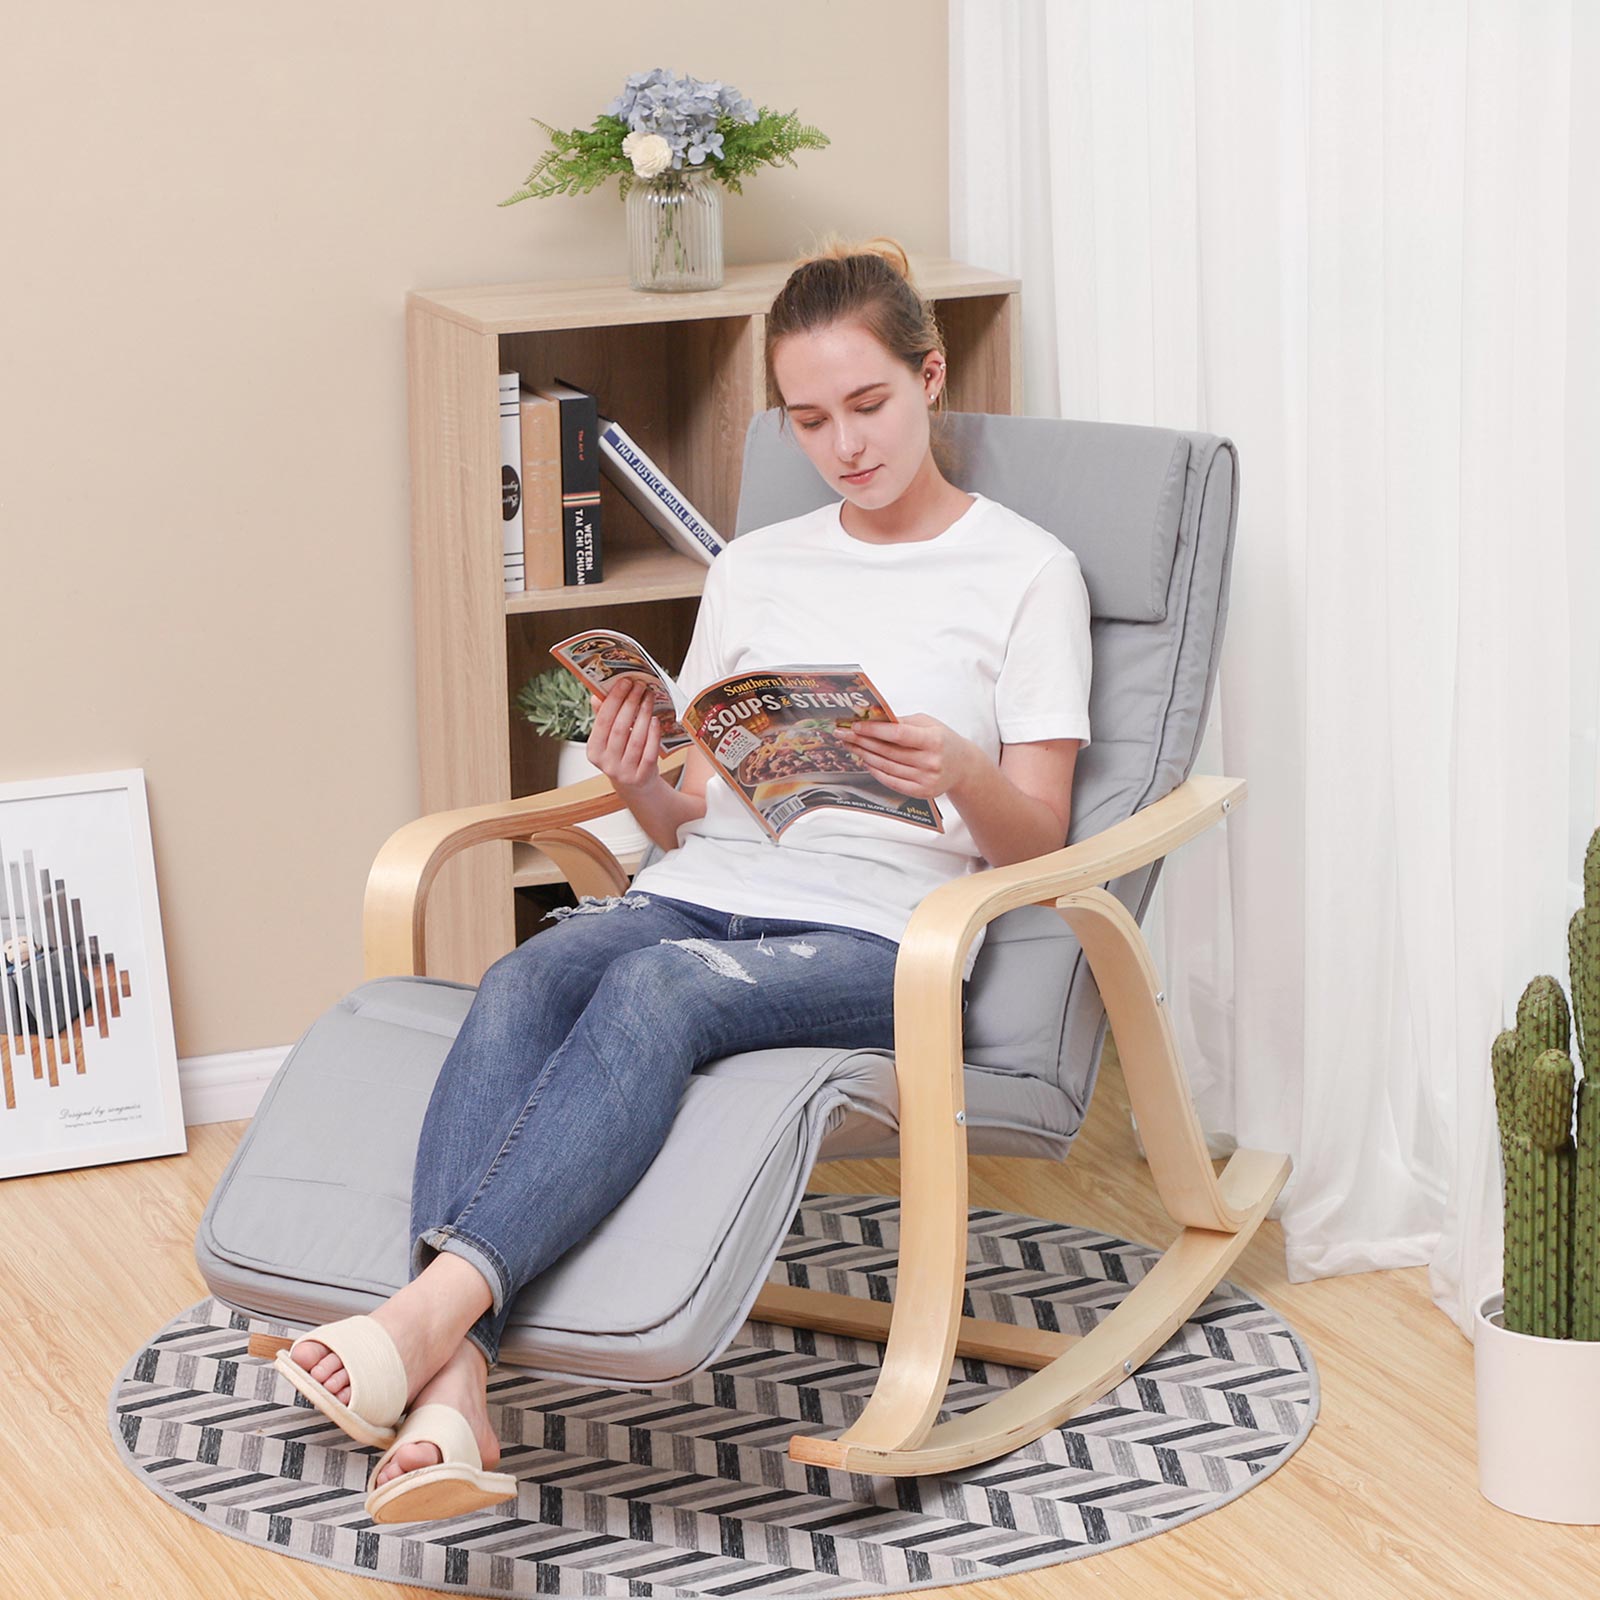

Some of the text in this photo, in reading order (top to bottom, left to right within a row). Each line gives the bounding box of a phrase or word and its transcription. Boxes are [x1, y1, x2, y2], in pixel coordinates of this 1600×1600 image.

[615, 440, 716, 550] THAT JUSTICE SHALL BE DONE
[575, 508, 585, 585] TAI CHI CHUAN
[584, 523, 593, 571] WESTERN
[723, 678, 778, 696] Southern
[777, 677, 818, 688] Living
[707, 694, 781, 739] SOUPS
[779, 695, 793, 707] &
[791, 691, 871, 709] STEWS
